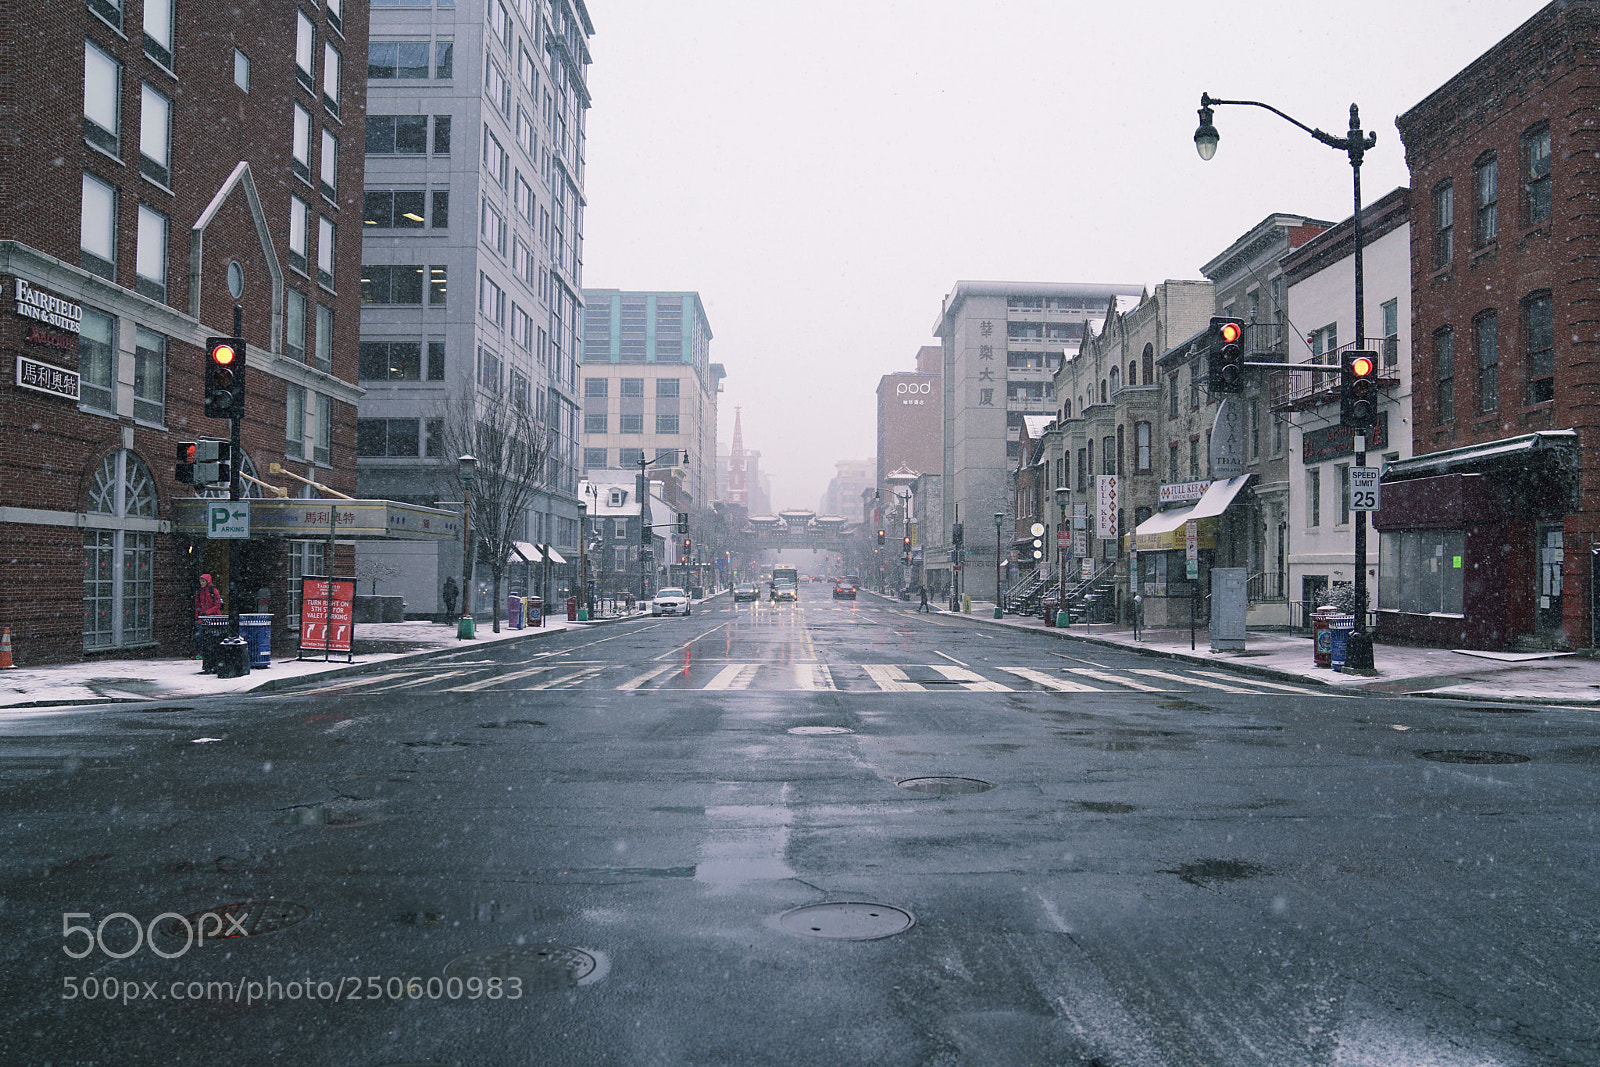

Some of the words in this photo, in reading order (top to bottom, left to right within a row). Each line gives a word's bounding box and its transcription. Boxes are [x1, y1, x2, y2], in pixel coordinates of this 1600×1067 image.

[15, 278, 82, 320] FAIRFIELD
[17, 303, 40, 320] INN
[40, 310, 48, 322] &
[49, 313, 80, 333] SUITES
[23, 363, 76, 395] 馬利奧特
[897, 380, 931, 396] pod
[1227, 402, 1238, 454] ROYAL
[1171, 486, 1185, 495] FULL
[1354, 491, 1375, 507] 25
